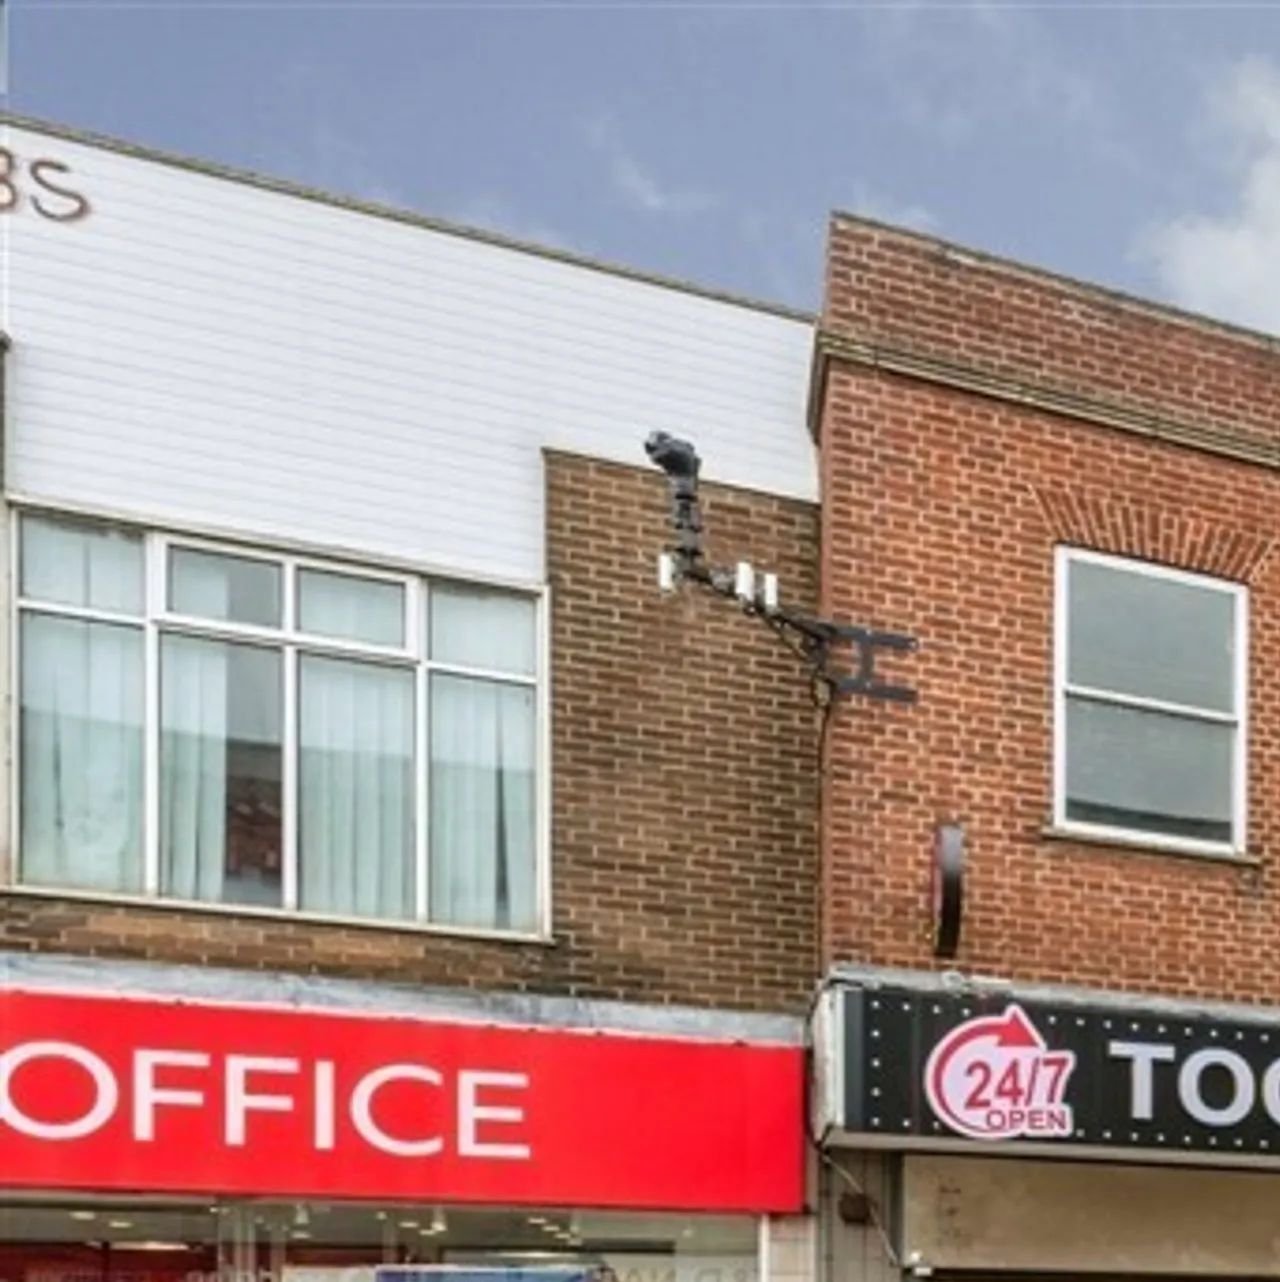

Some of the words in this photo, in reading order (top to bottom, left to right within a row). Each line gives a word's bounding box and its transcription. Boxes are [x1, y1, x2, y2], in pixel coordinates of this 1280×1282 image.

[0, 1040, 531, 1161] OFFICE
[964, 1055, 1070, 1108] 24/7
[985, 1107, 1068, 1132] OPEN
